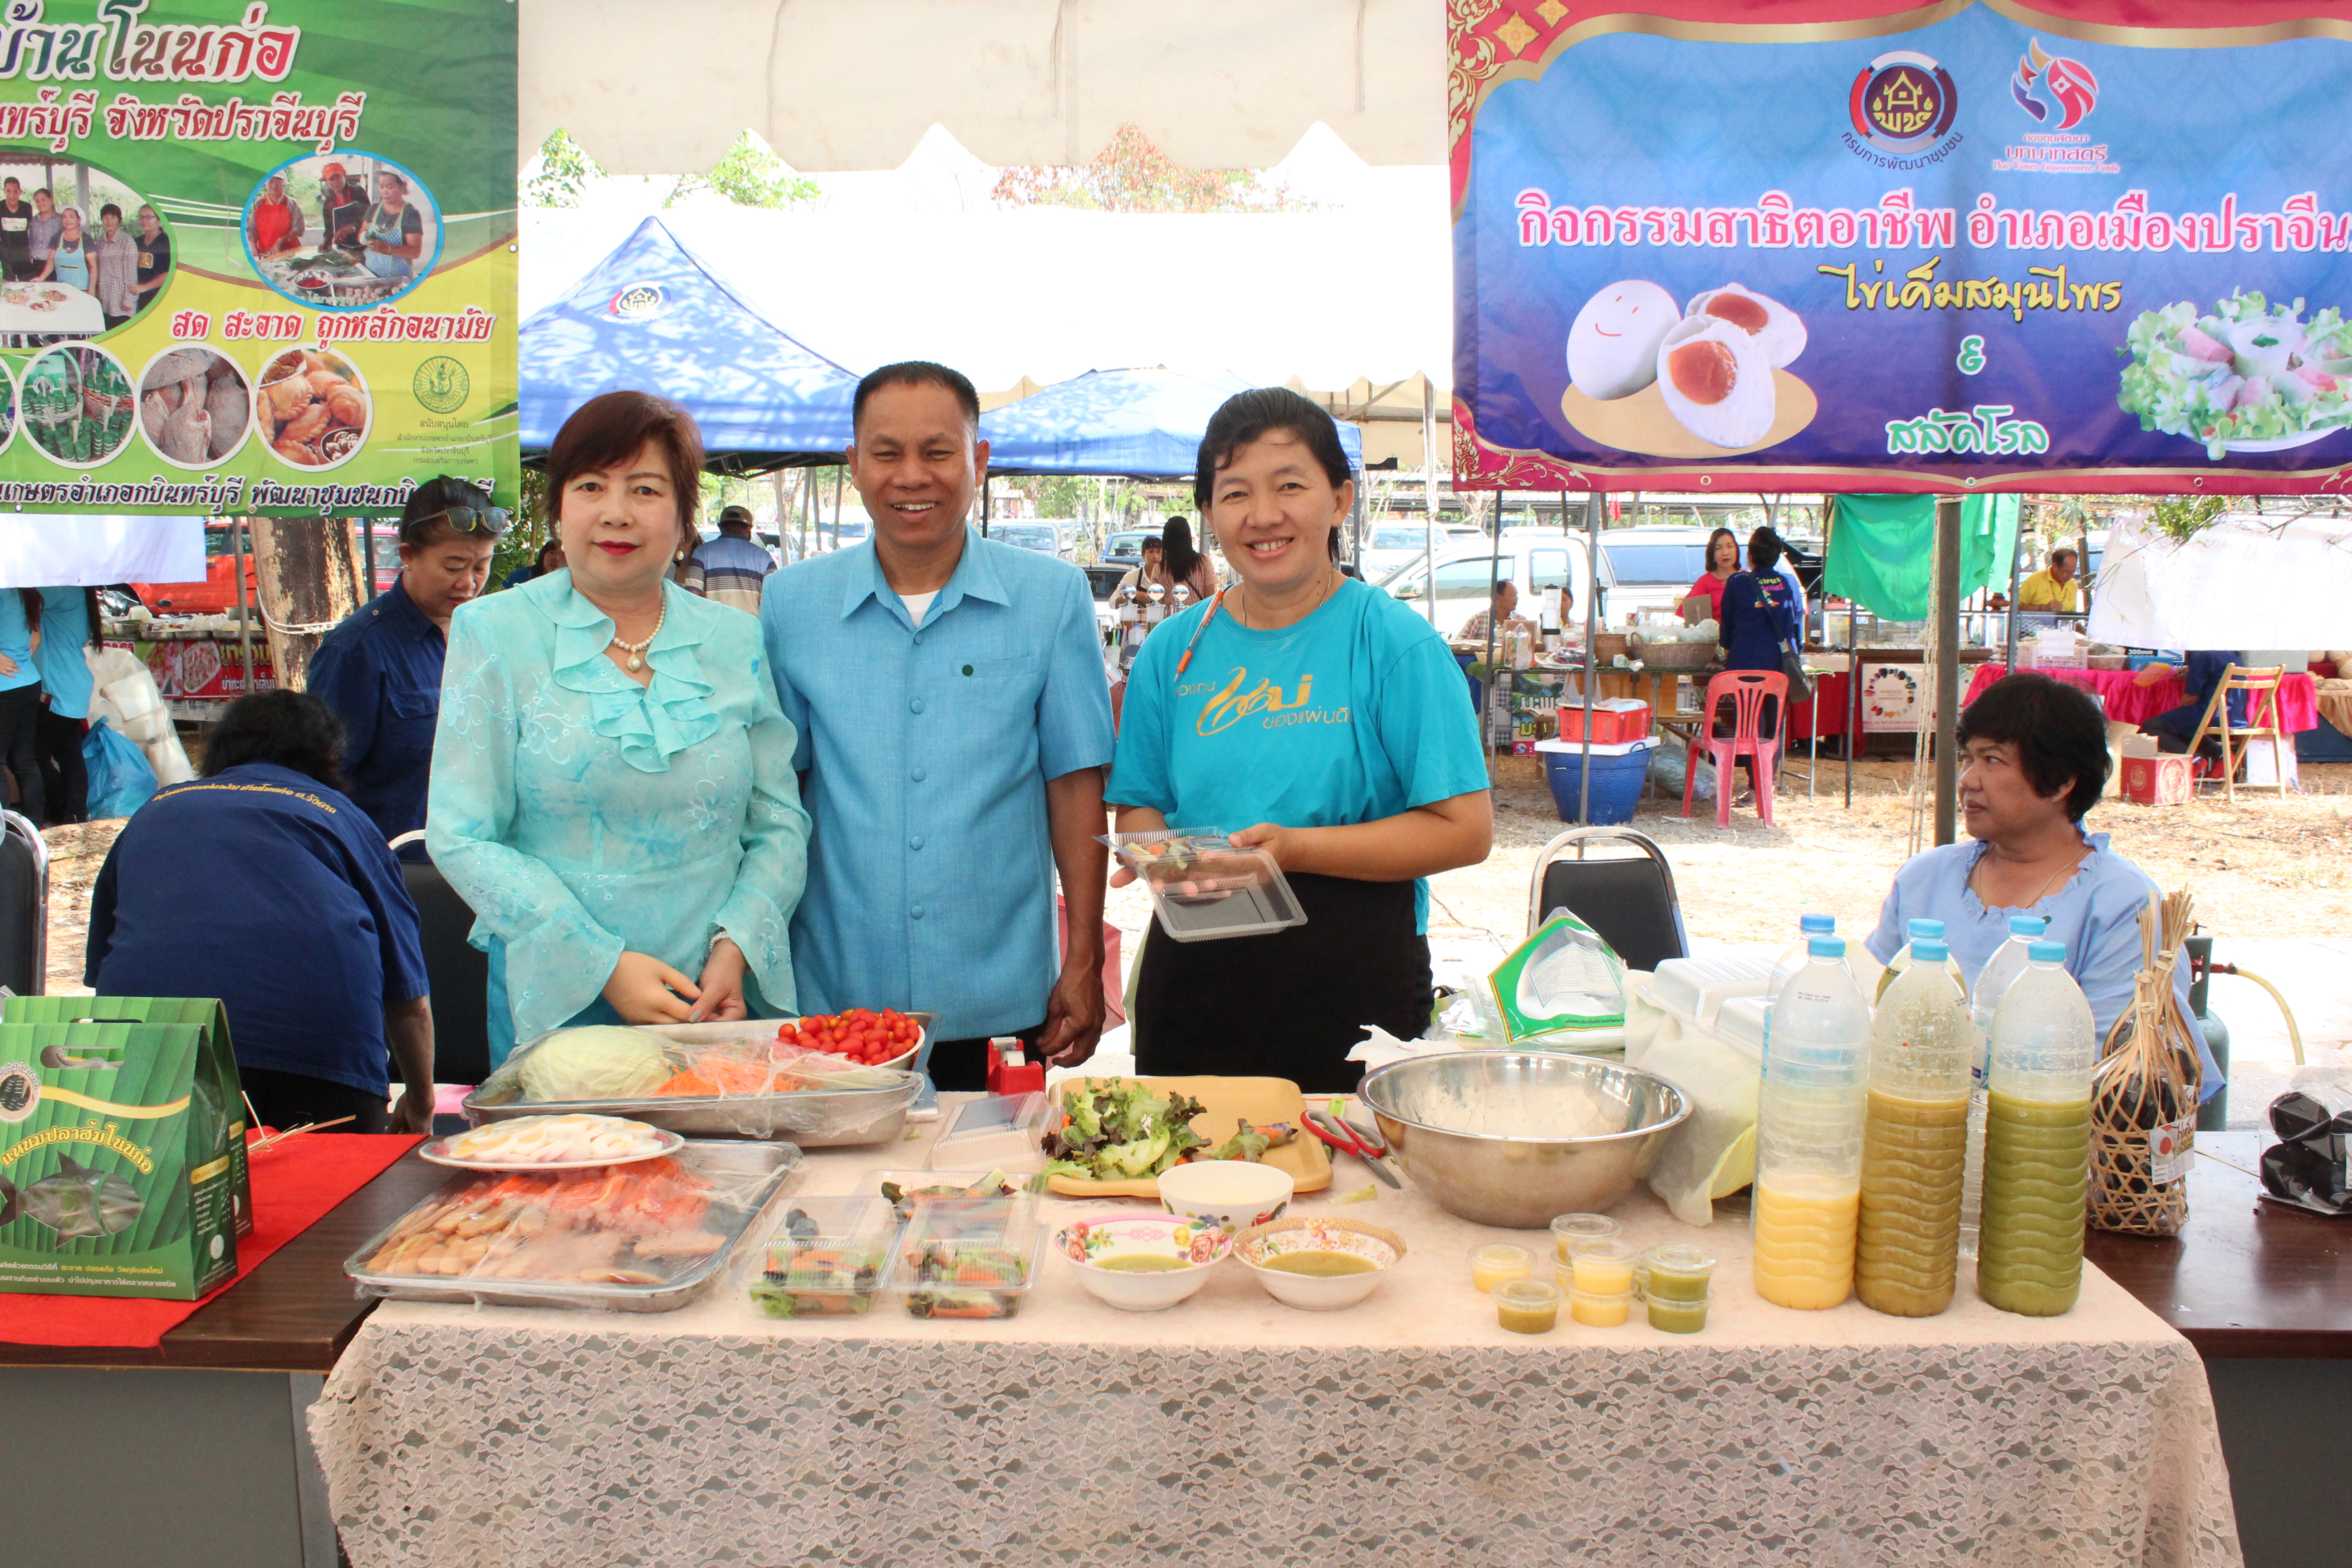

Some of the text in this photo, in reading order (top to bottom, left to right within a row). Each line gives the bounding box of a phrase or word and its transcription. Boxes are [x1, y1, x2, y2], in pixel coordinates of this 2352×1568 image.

[106, 92, 365, 152] จังหวัดปราจีนบุรี
[2024, 134, 2088, 143] กองทุนพัฒนา
[1842, 132, 1964, 170] กรมการพัฒนาชุมชน
[2006, 146, 2107, 161] บทบาทสตรี
[2042, 163, 2092, 172] Empowerment
[1518, 188, 2352, 253] กิจกรรมสาธิตอาชีพ อำเภอเมืองปราจีน
[1818, 256, 2122, 321] ไข่เค็มสมุนไพร
[172, 304, 496, 352] สด สะอาด ถูกหลักอนามัย
[1957, 335, 1985, 375] &
[420, 418, 468, 430] สนับสนุนโดย
[1886, 405, 2049, 455] สลัดโรล
[2163, 773, 2185, 792] LEO
[0, 1061, 41, 1089] าส้มโนนก่อ
[1, 1119, 153, 1175] แหนมปลาส้มโนนก่อ
